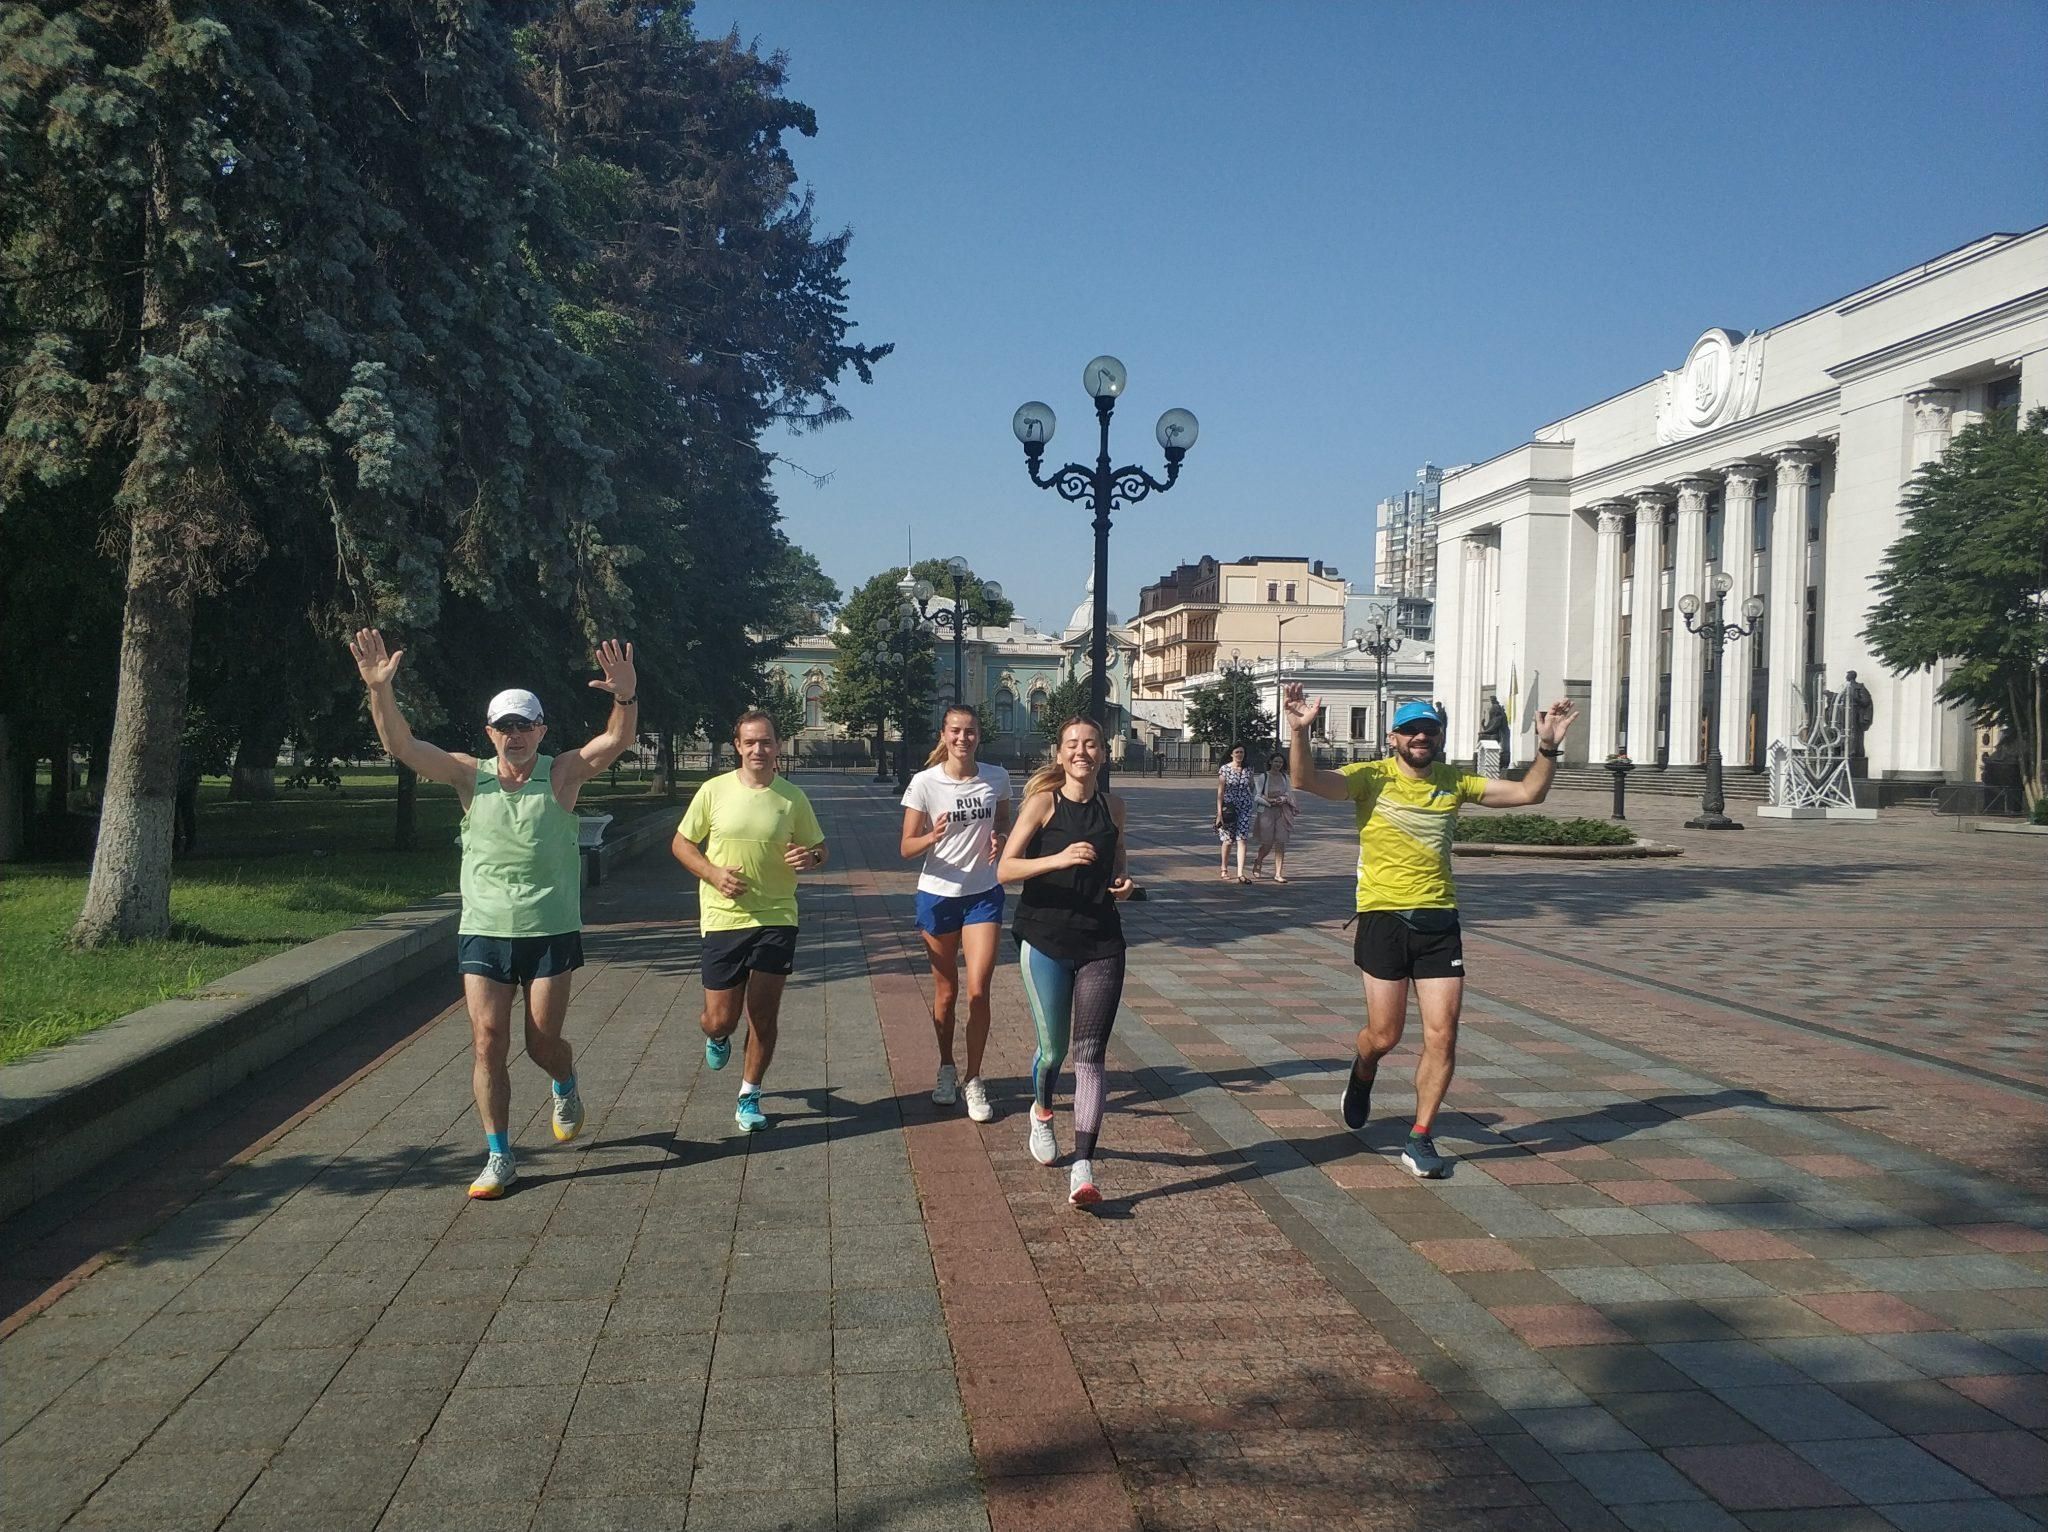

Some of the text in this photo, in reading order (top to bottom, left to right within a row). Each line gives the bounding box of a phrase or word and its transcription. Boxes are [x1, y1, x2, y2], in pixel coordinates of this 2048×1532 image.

[956, 797, 982, 809] RUN
[947, 808, 992, 822] THE SUN
